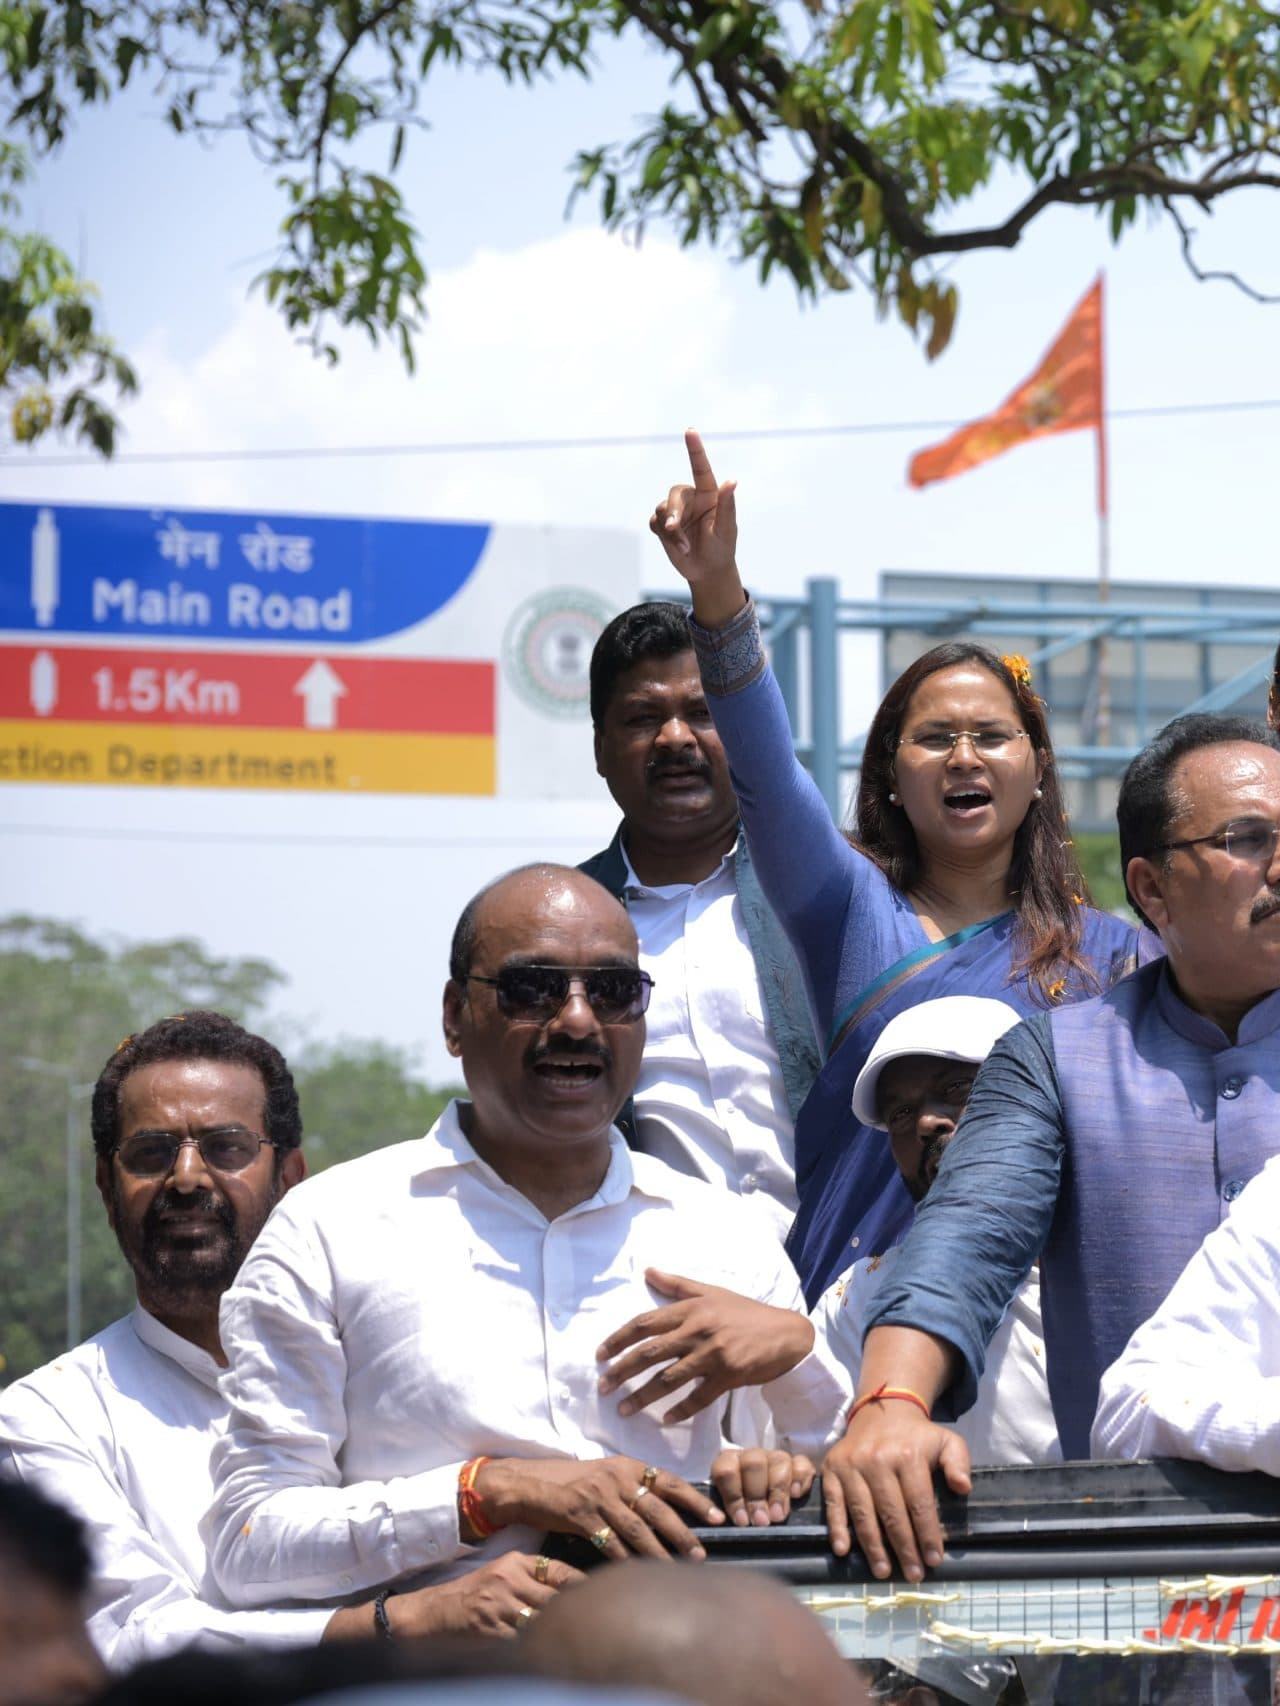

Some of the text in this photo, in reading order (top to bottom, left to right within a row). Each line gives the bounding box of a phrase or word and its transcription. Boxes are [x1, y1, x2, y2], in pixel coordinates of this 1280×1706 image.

[156, 516, 315, 572] मेन रोड
[93, 577, 352, 632] Main Road
[93, 666, 241, 714] 1.5Km
[107, 744, 337, 784] Department
[1142, 1586, 1246, 1641] JAI
